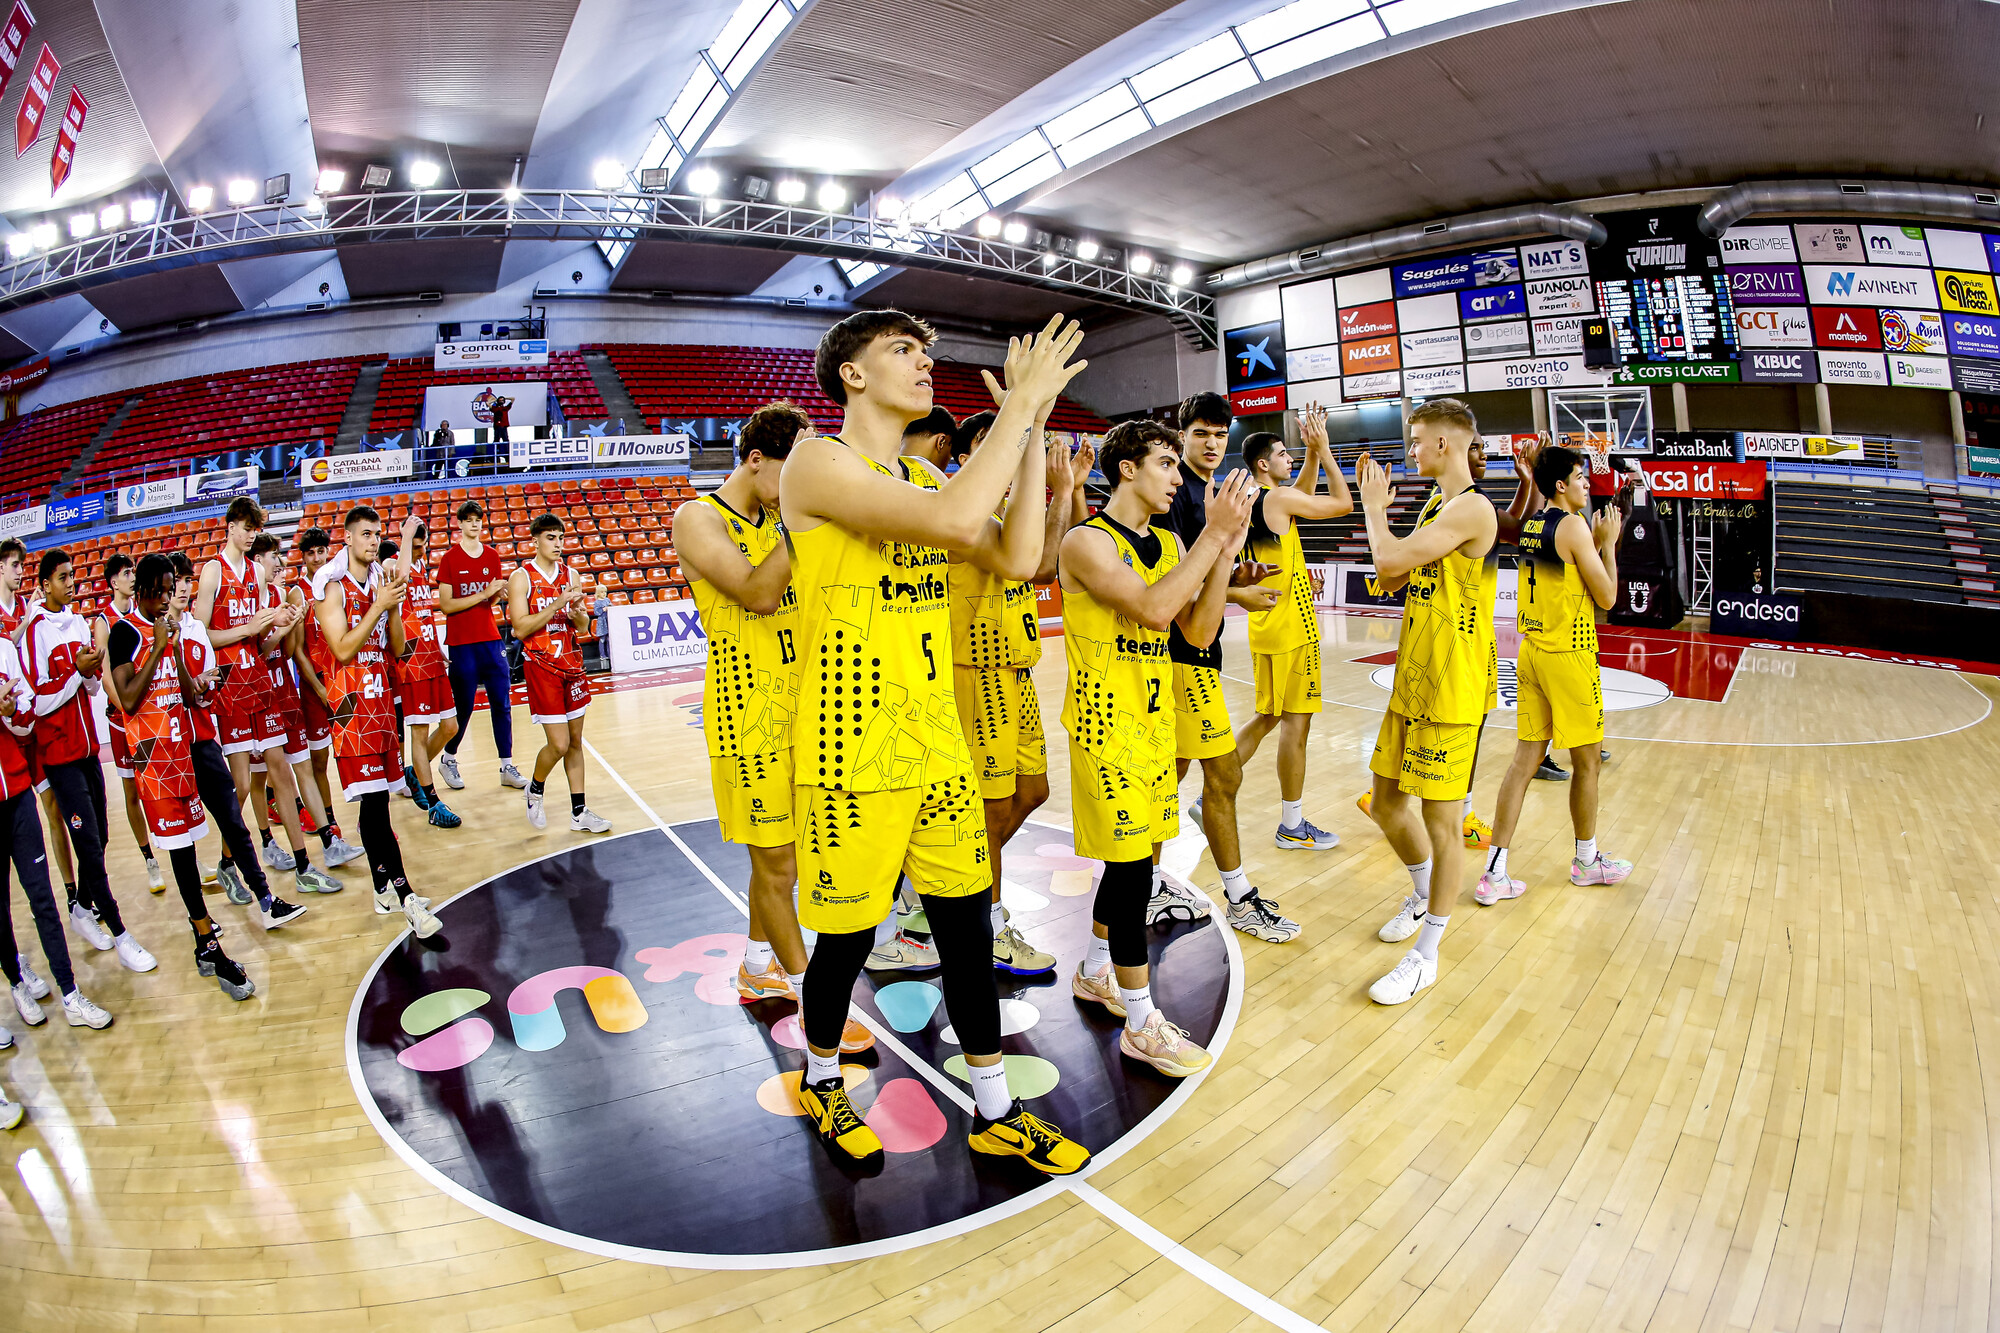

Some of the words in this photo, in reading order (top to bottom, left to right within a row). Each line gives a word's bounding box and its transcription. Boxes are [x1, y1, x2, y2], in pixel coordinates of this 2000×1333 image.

[1401, 263, 1469, 281] Sagalés
[1407, 277, 1465, 291] www.sagales.com
[1528, 279, 1589, 295] JUANOLA
[1857, 279, 1918, 295] AVINENT
[1538, 302, 1568, 310] expert
[1589, 325, 1603, 335] 00
[1737, 312, 1779, 330] GCT
[1782, 316, 1806, 335] plus
[1828, 332, 1868, 343] montepio
[1973, 324, 1997, 338] GOL
[1414, 334, 1459, 346] santasusana
[462, 344, 514, 352] CONTROL
[1348, 344, 1392, 360] NACEX
[1505, 360, 1569, 375] movento
[1753, 354, 1802, 369] KIBUC
[1827, 360, 1867, 369] movento
[13, 367, 48, 386] MANRESA
[1406, 368, 1461, 380] Sagalés
[1638, 366, 1673, 378] COTS
[1681, 365, 1730, 376] CLARET
[1828, 368, 1854, 377] sarsa
[1506, 375, 1547, 388] sarsa
[1246, 395, 1277, 407] Occident
[1758, 437, 1800, 452] AIGNEP
[333, 456, 382, 467] CATALANA
[333, 467, 345, 475] DE
[346, 465, 382, 474] TREBALL
[1693, 465, 1714, 492] id
[147, 483, 167, 494] Salut
[147, 492, 176, 503] Manresa
[55, 507, 79, 522] FEDAC
[1628, 582, 1650, 591] LIGA
[1716, 598, 1799, 623] endesa
[420, 624, 435, 642] 20
[1022, 612, 1037, 642] 6
[551, 639, 562, 658] 7
[777, 629, 797, 665] 13
[922, 632, 936, 681] 5
[362, 673, 384, 699] 24
[570, 687, 582, 697] ETL
[169, 716, 183, 743] 2
[1418, 745, 1434, 755] Islas
[1411, 767, 1444, 781] Hospiten
